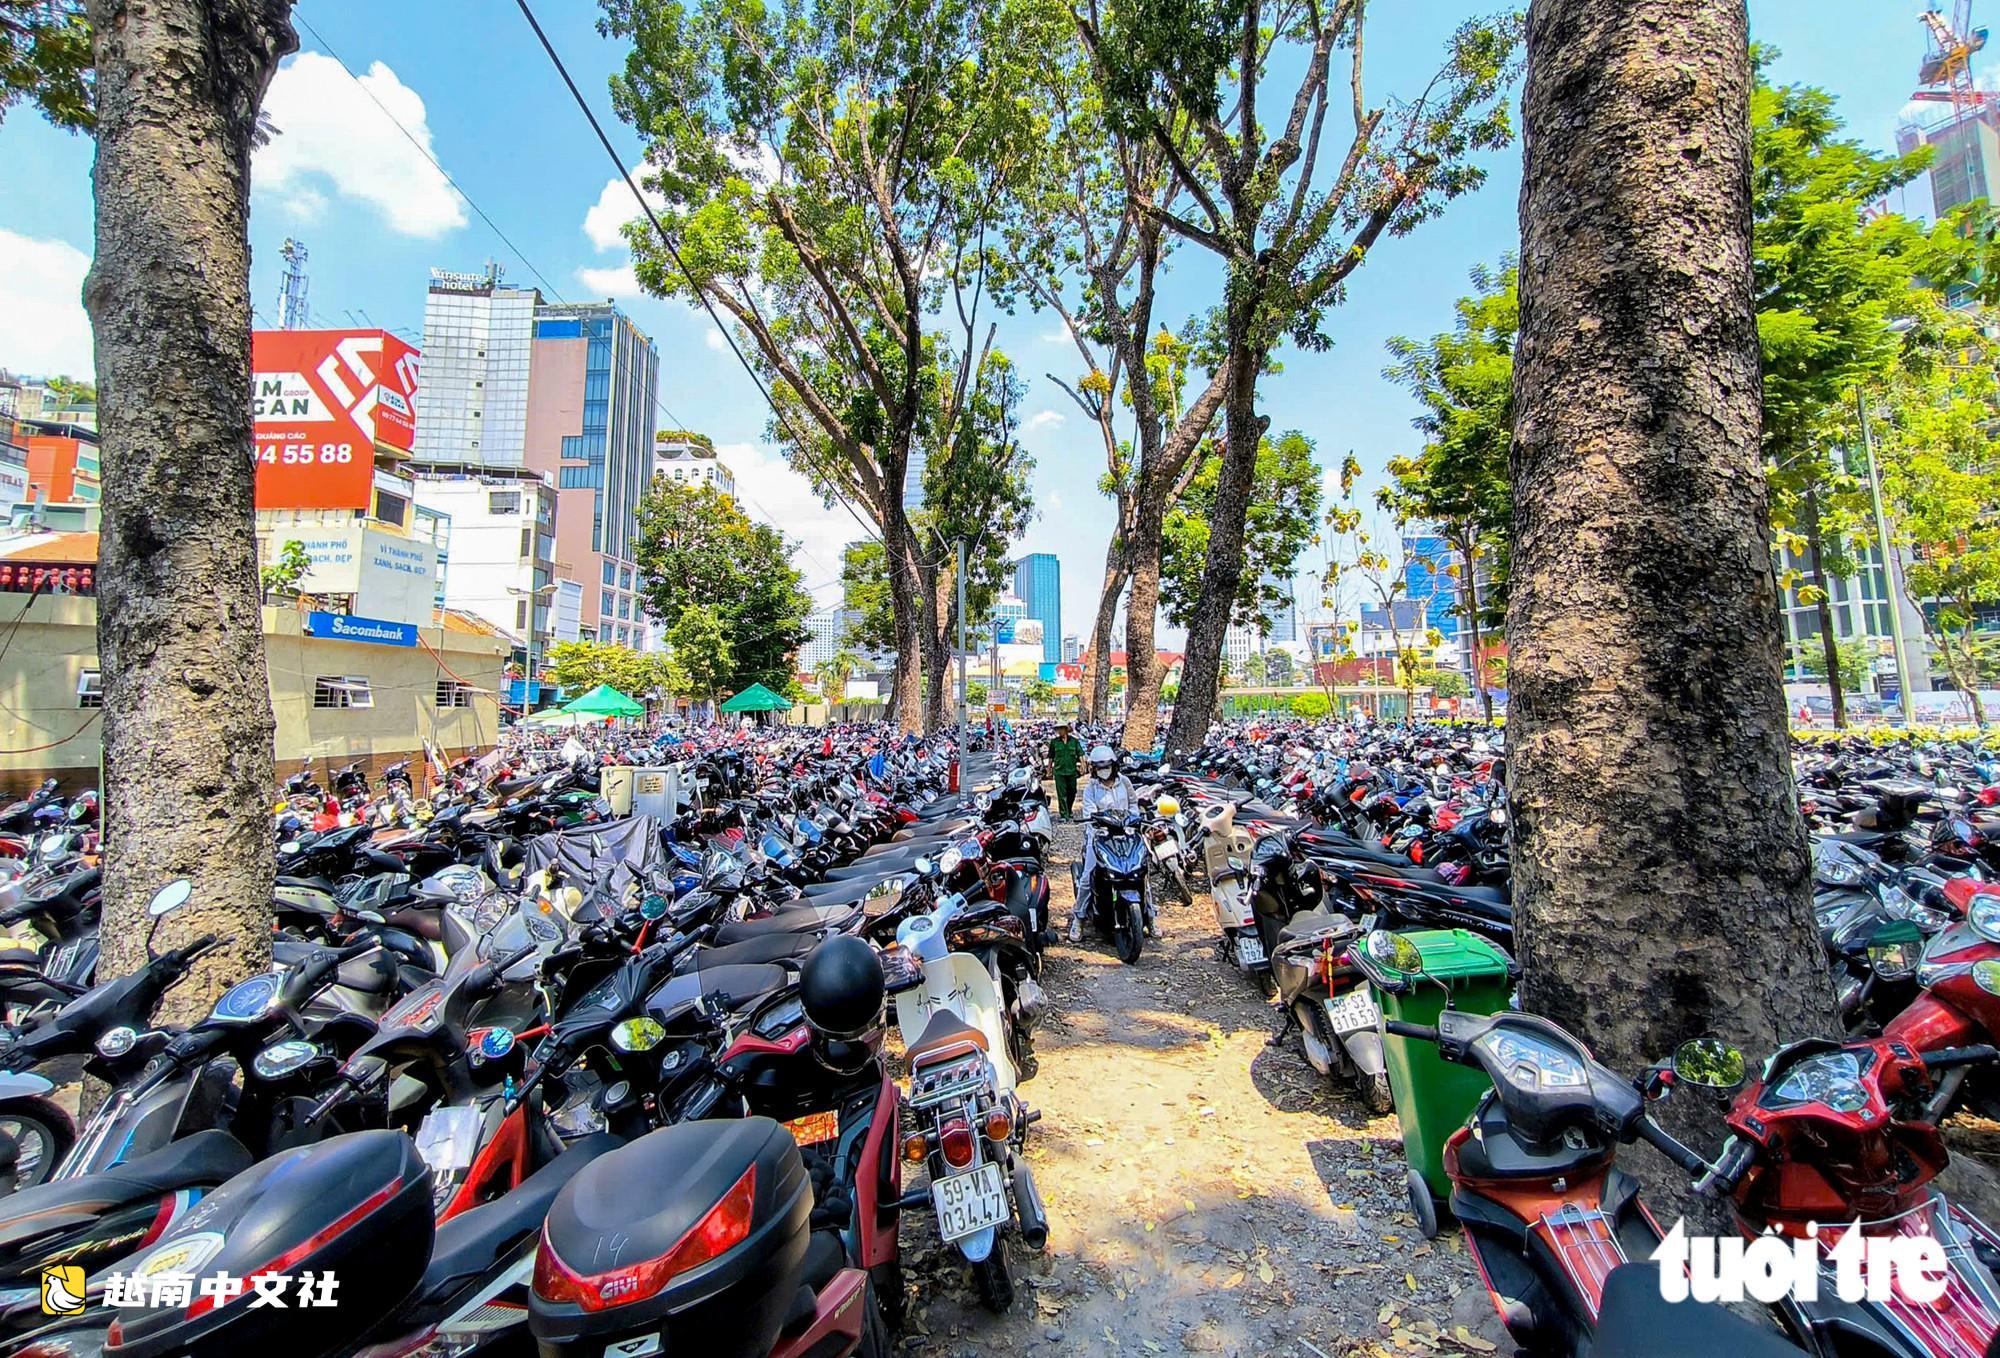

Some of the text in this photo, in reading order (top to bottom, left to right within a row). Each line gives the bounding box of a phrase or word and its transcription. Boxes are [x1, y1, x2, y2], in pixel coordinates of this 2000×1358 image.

[442, 280, 474, 291] hotel
[251, 380, 282, 397] IM
[251, 398, 309, 415] GAN
[283, 444, 314, 464] 55
[320, 443, 352, 463] 88
[332, 617, 404, 641] Sacombank
[942, 1193, 1001, 1234] 034.47
[600, 1276, 638, 1300] GIVI
